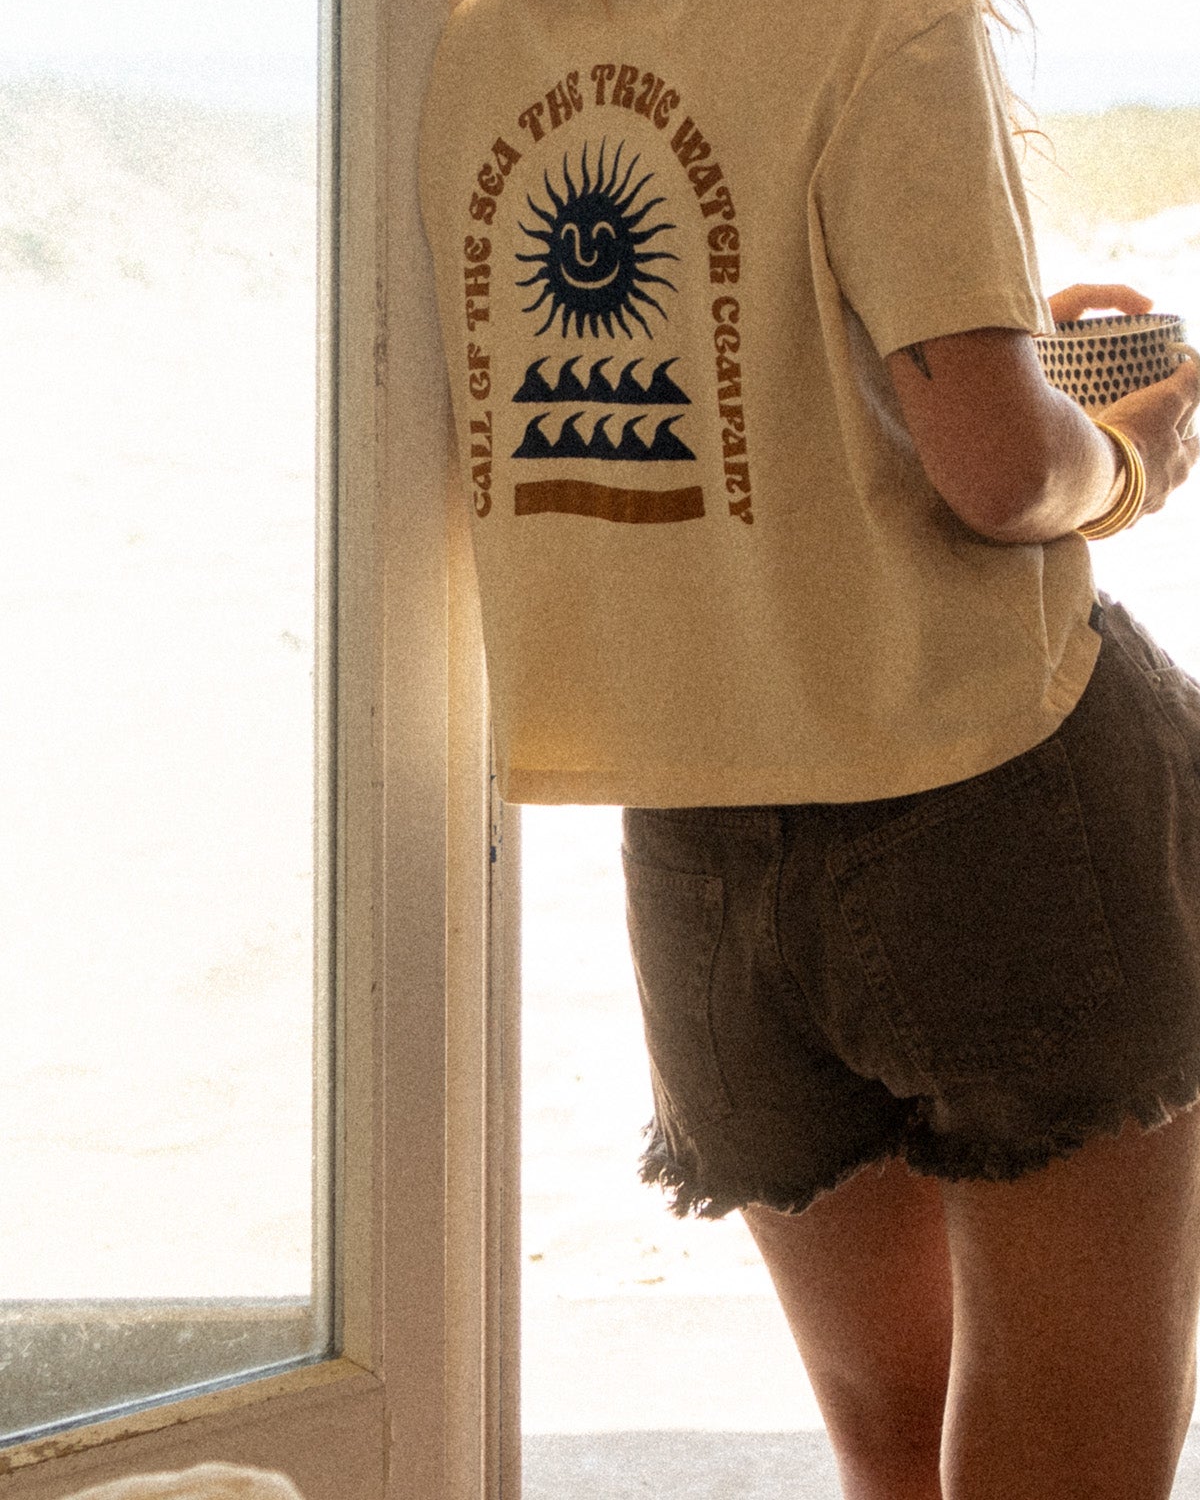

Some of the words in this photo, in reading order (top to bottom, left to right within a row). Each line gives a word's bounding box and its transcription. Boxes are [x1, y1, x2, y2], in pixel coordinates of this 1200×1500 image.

[518, 71, 584, 143] THE
[591, 64, 680, 130] TRUE
[471, 137, 522, 225] SEA
[670, 116, 740, 284] WATER
[465, 236, 491, 331] THE
[468, 343, 493, 400] OF
[712, 296, 754, 525] COMPANY
[471, 410, 493, 518] CALL
